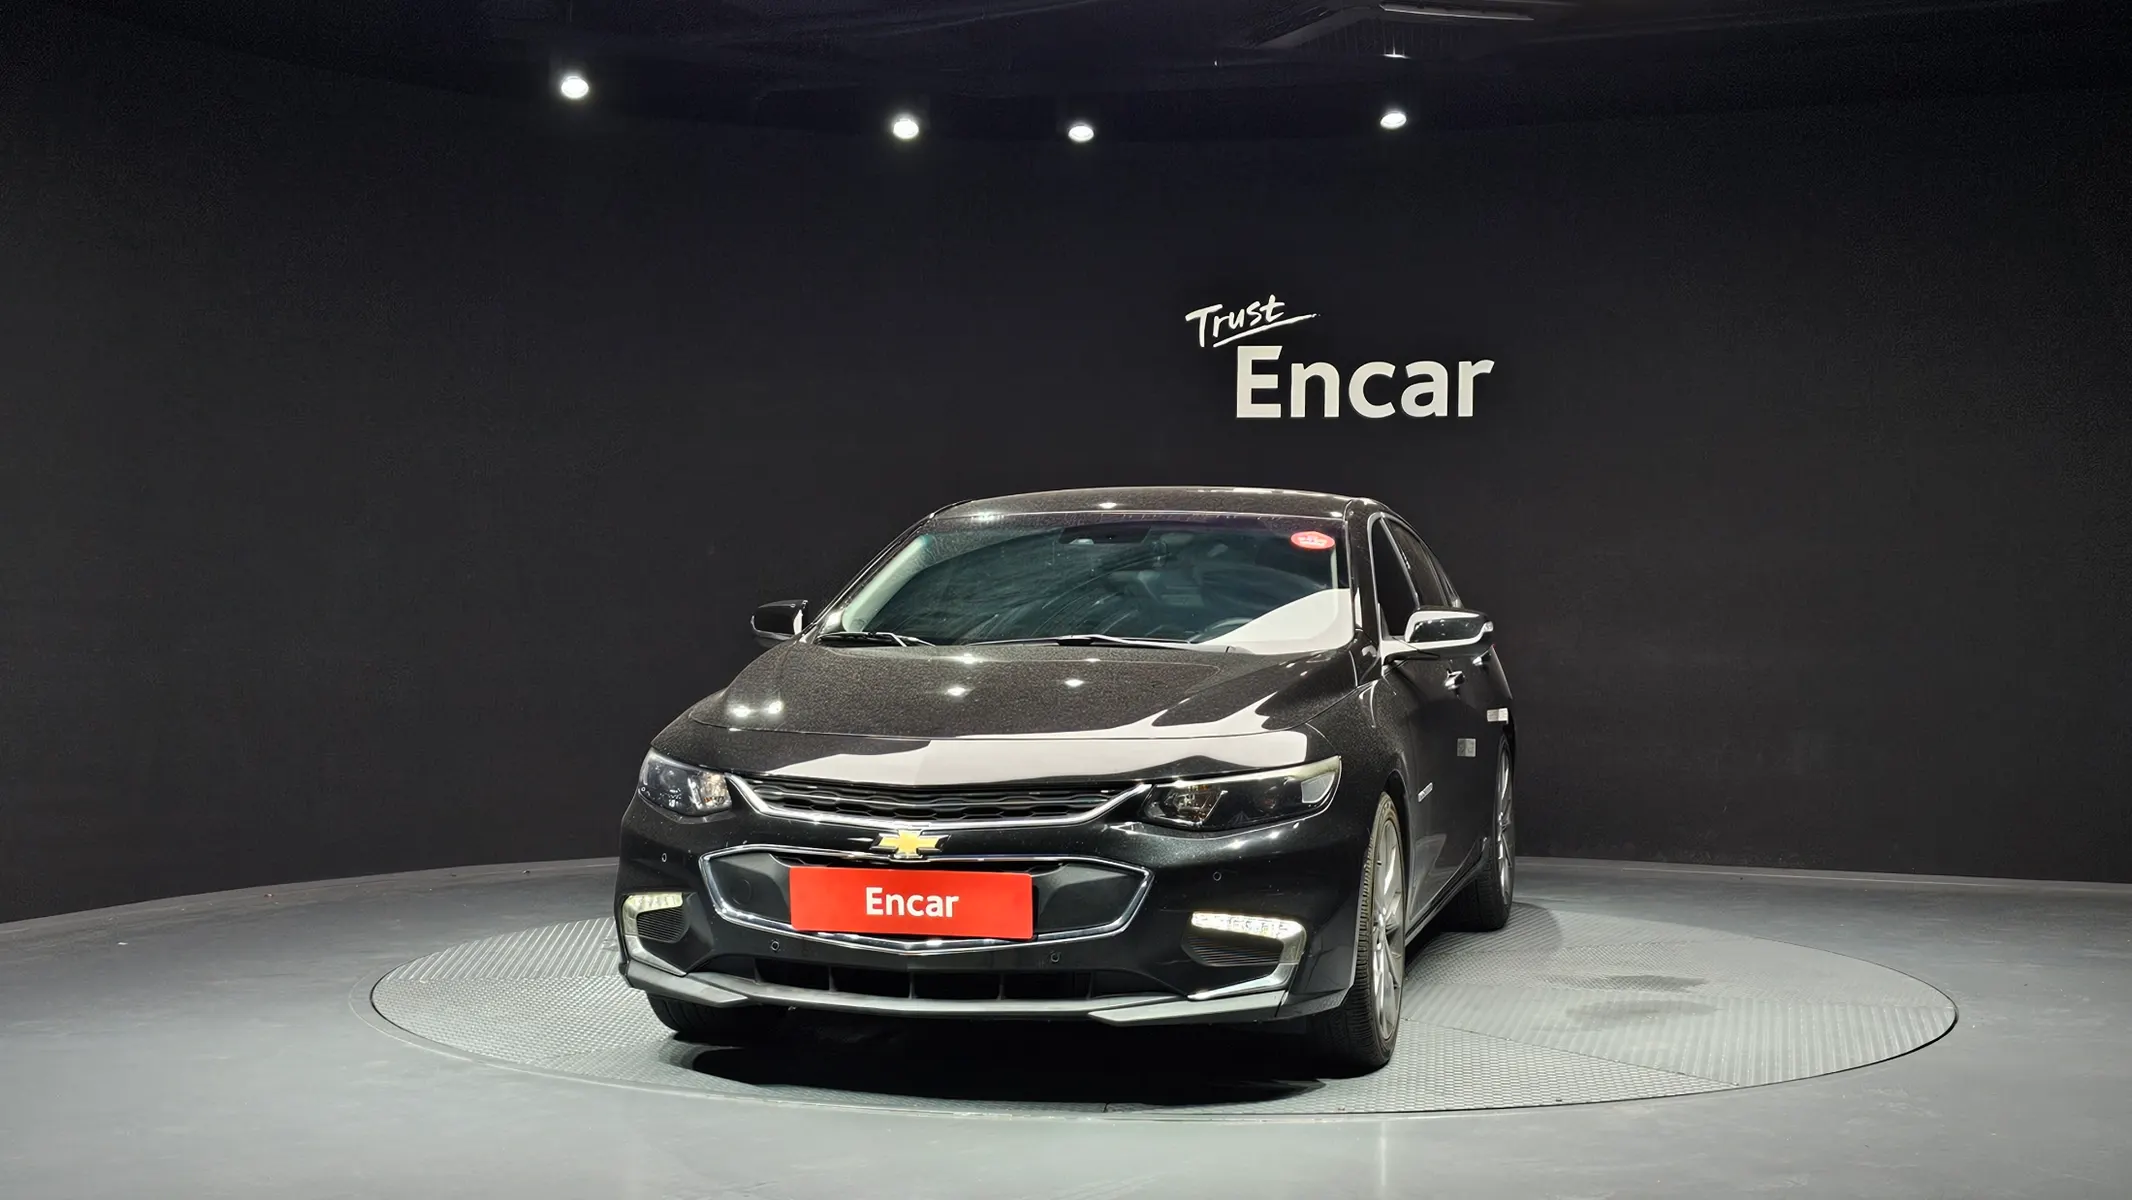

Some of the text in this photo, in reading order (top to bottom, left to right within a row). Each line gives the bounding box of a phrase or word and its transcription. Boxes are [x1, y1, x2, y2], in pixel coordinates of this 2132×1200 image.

[1185, 294, 1286, 348] Trust
[1236, 345, 1495, 418] Encar
[865, 887, 959, 918] Encar
